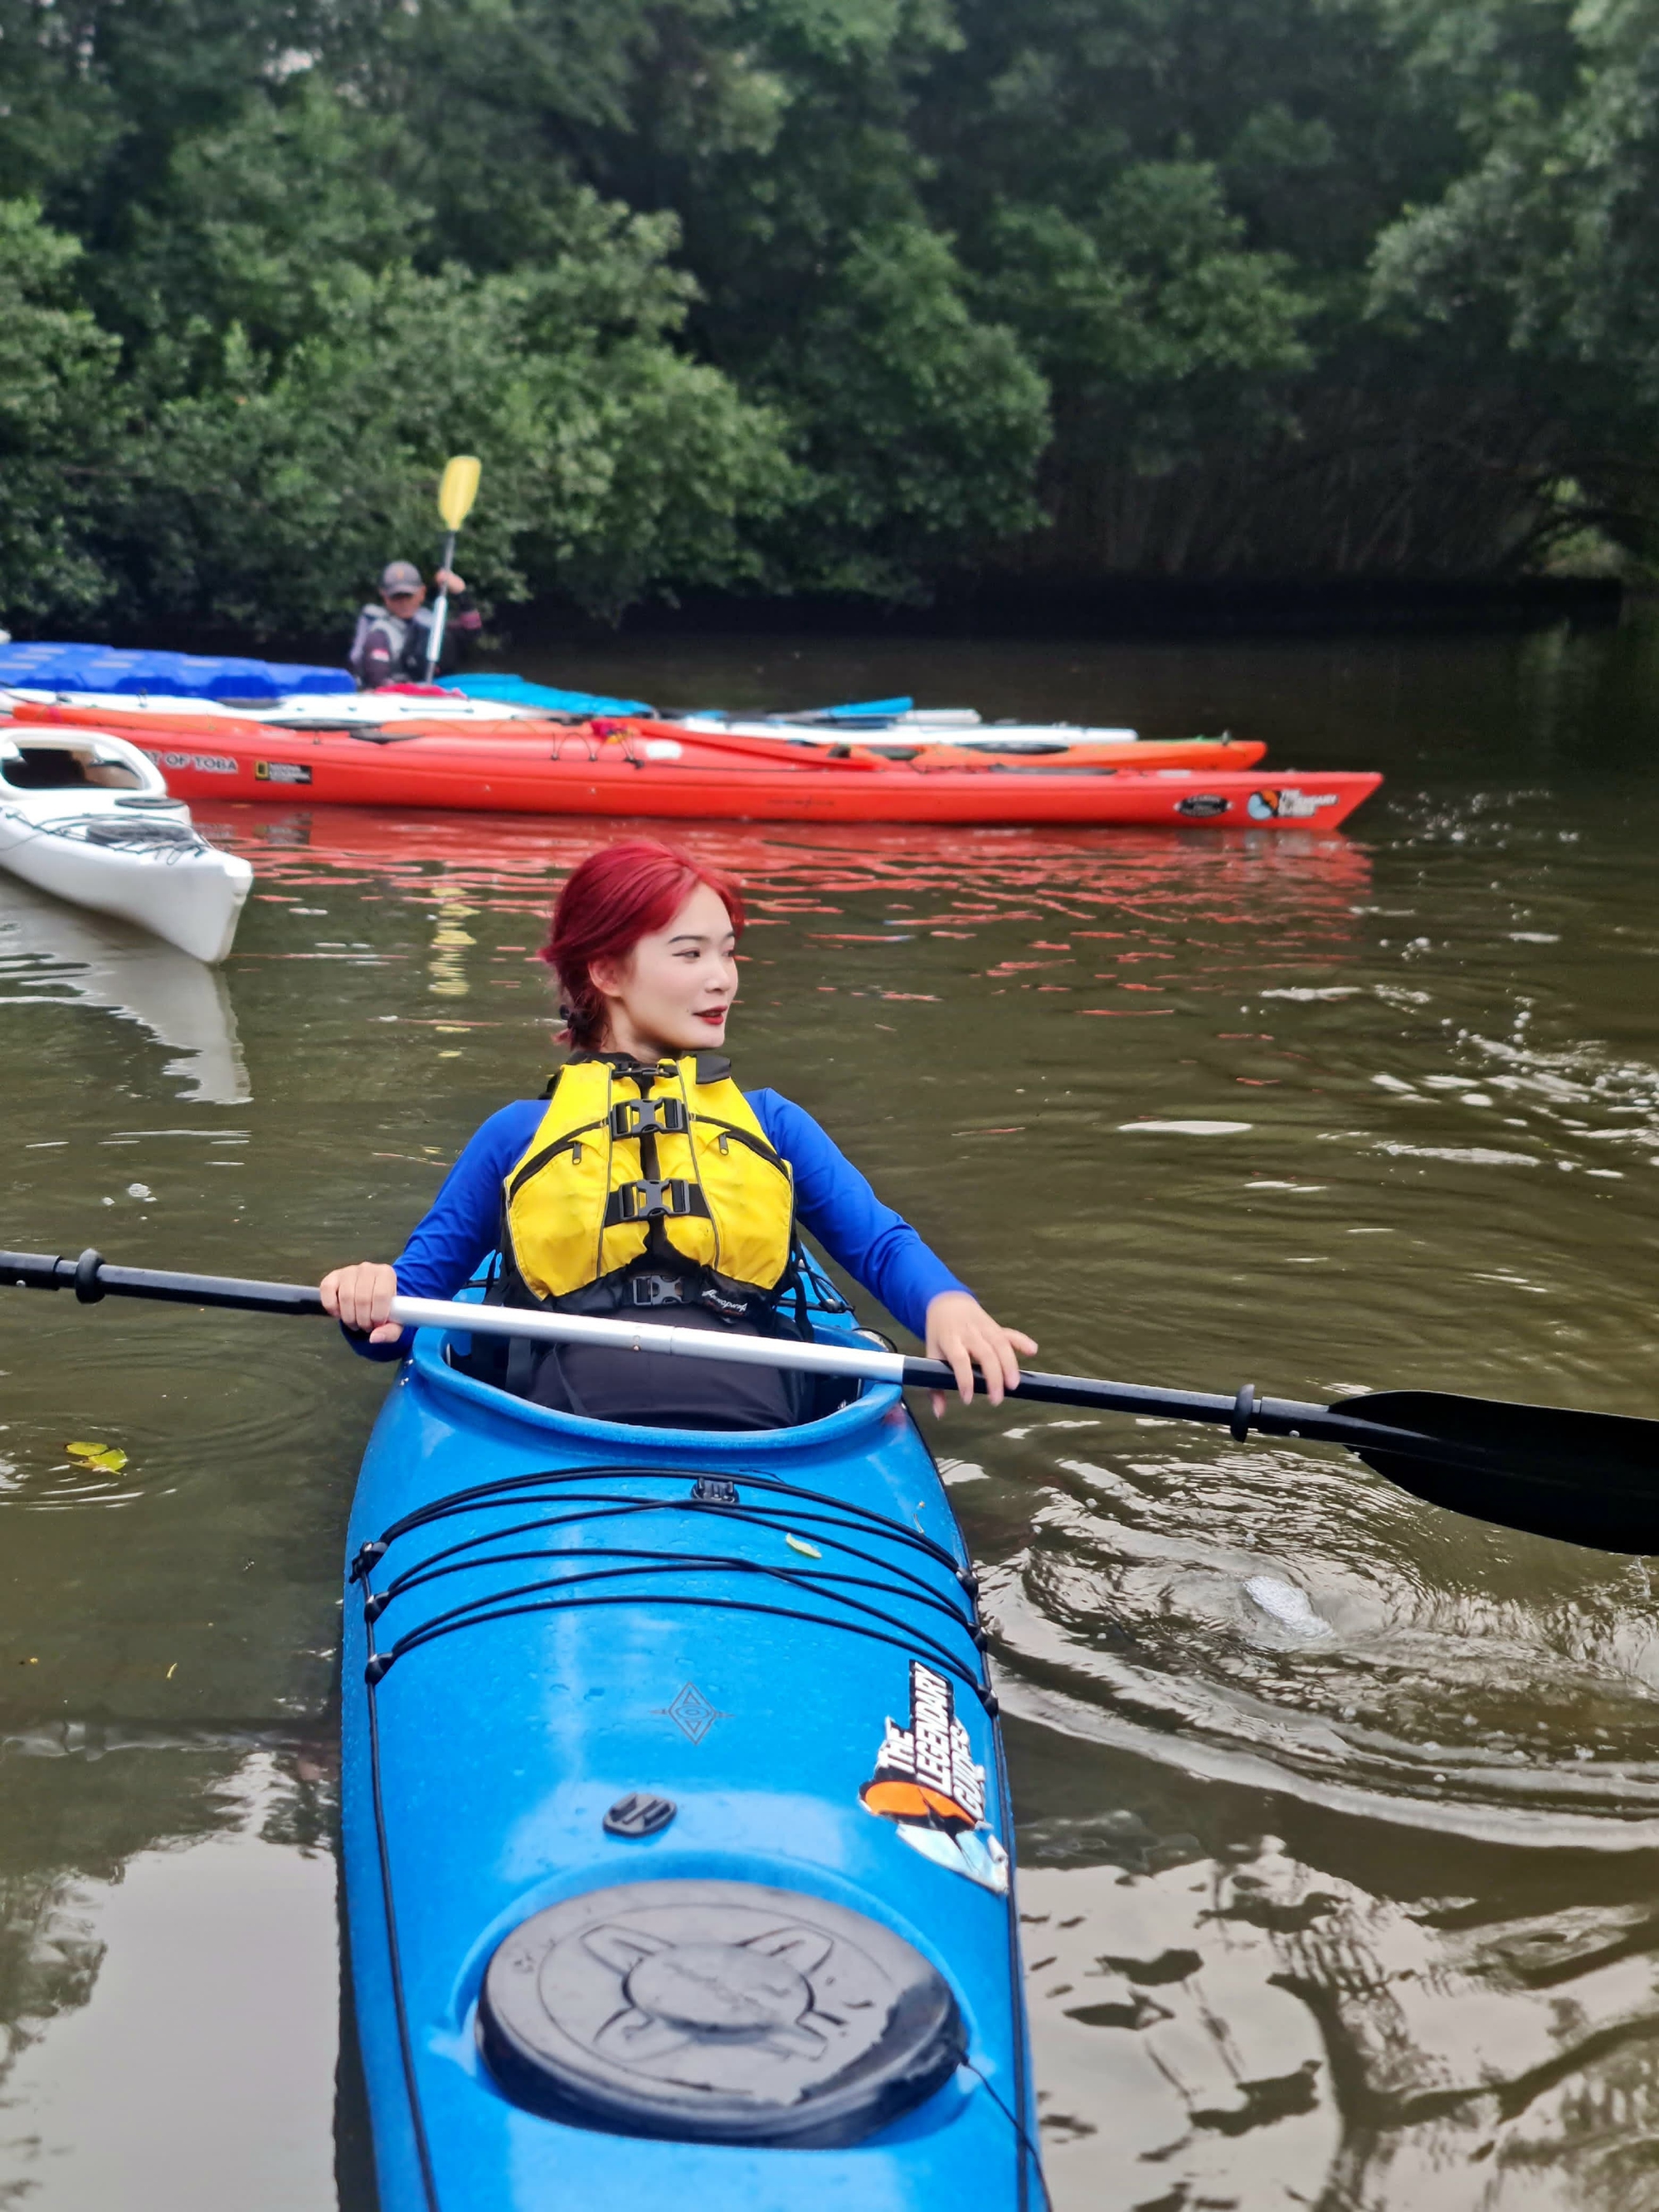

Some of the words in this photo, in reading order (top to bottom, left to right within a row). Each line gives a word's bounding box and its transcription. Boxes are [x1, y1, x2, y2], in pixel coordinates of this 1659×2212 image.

[165, 752, 189, 766] OF
[194, 756, 237, 771] TOBA
[878, 1727, 916, 1775] THE
[914, 1660, 953, 1797] LEGENDARY
[949, 1723, 985, 1822] GUIDES
